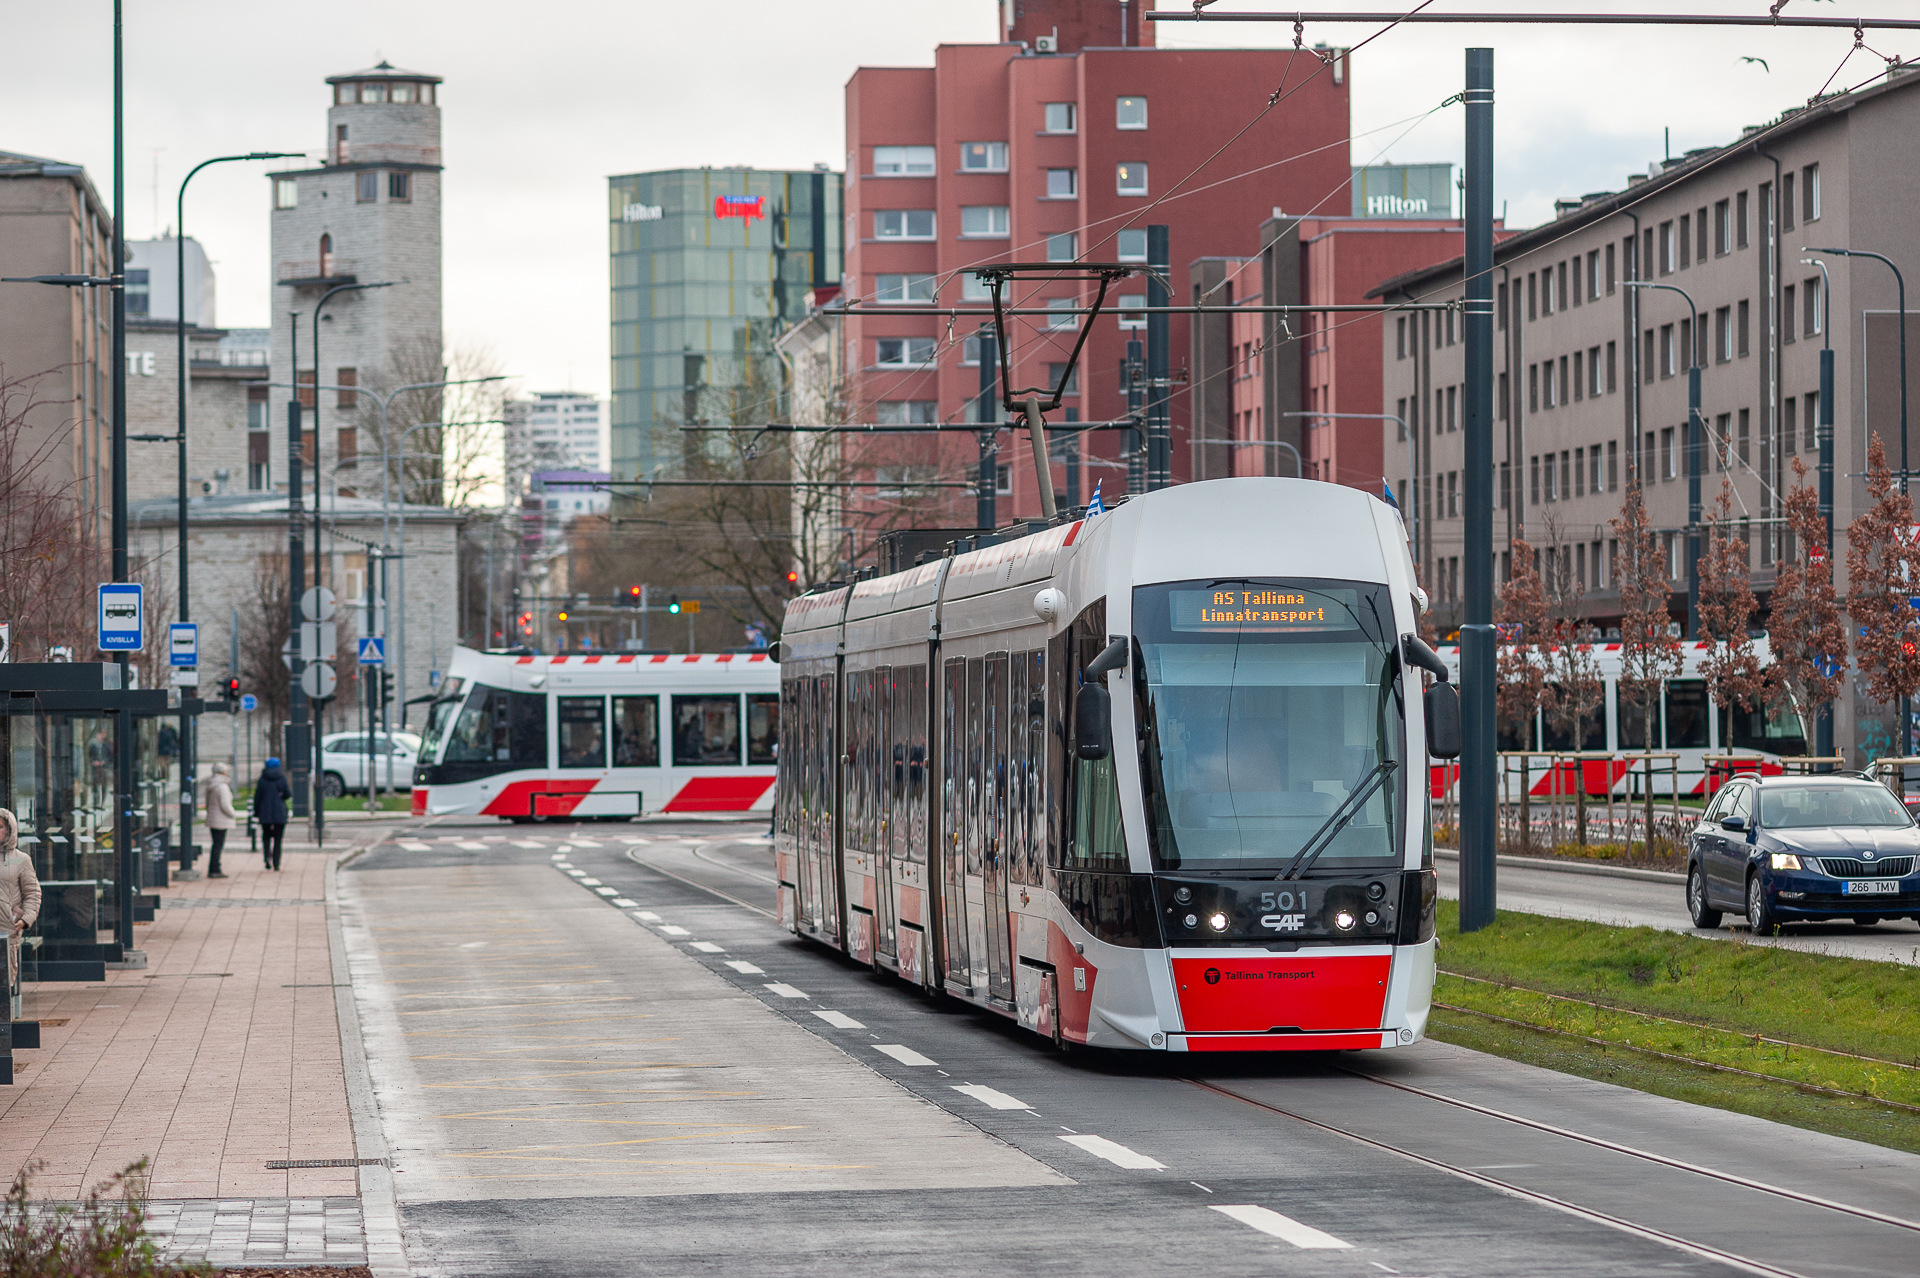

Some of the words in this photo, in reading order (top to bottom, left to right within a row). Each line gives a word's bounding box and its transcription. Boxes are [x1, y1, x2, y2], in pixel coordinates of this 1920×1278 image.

[623, 202, 663, 222] Hilton
[1368, 194, 1428, 214] Hilton
[1213, 591, 1235, 605] AS
[1242, 591, 1305, 605] Tallinna
[1202, 607, 1324, 622] Linnatransport
[1851, 882, 1869, 892] 266
[1875, 881, 1896, 892] TMV
[1261, 890, 1307, 911] 501
[1260, 913, 1306, 931] CAF
[1225, 971, 1264, 980] Tallinna
[1266, 970, 1315, 980] Transport
